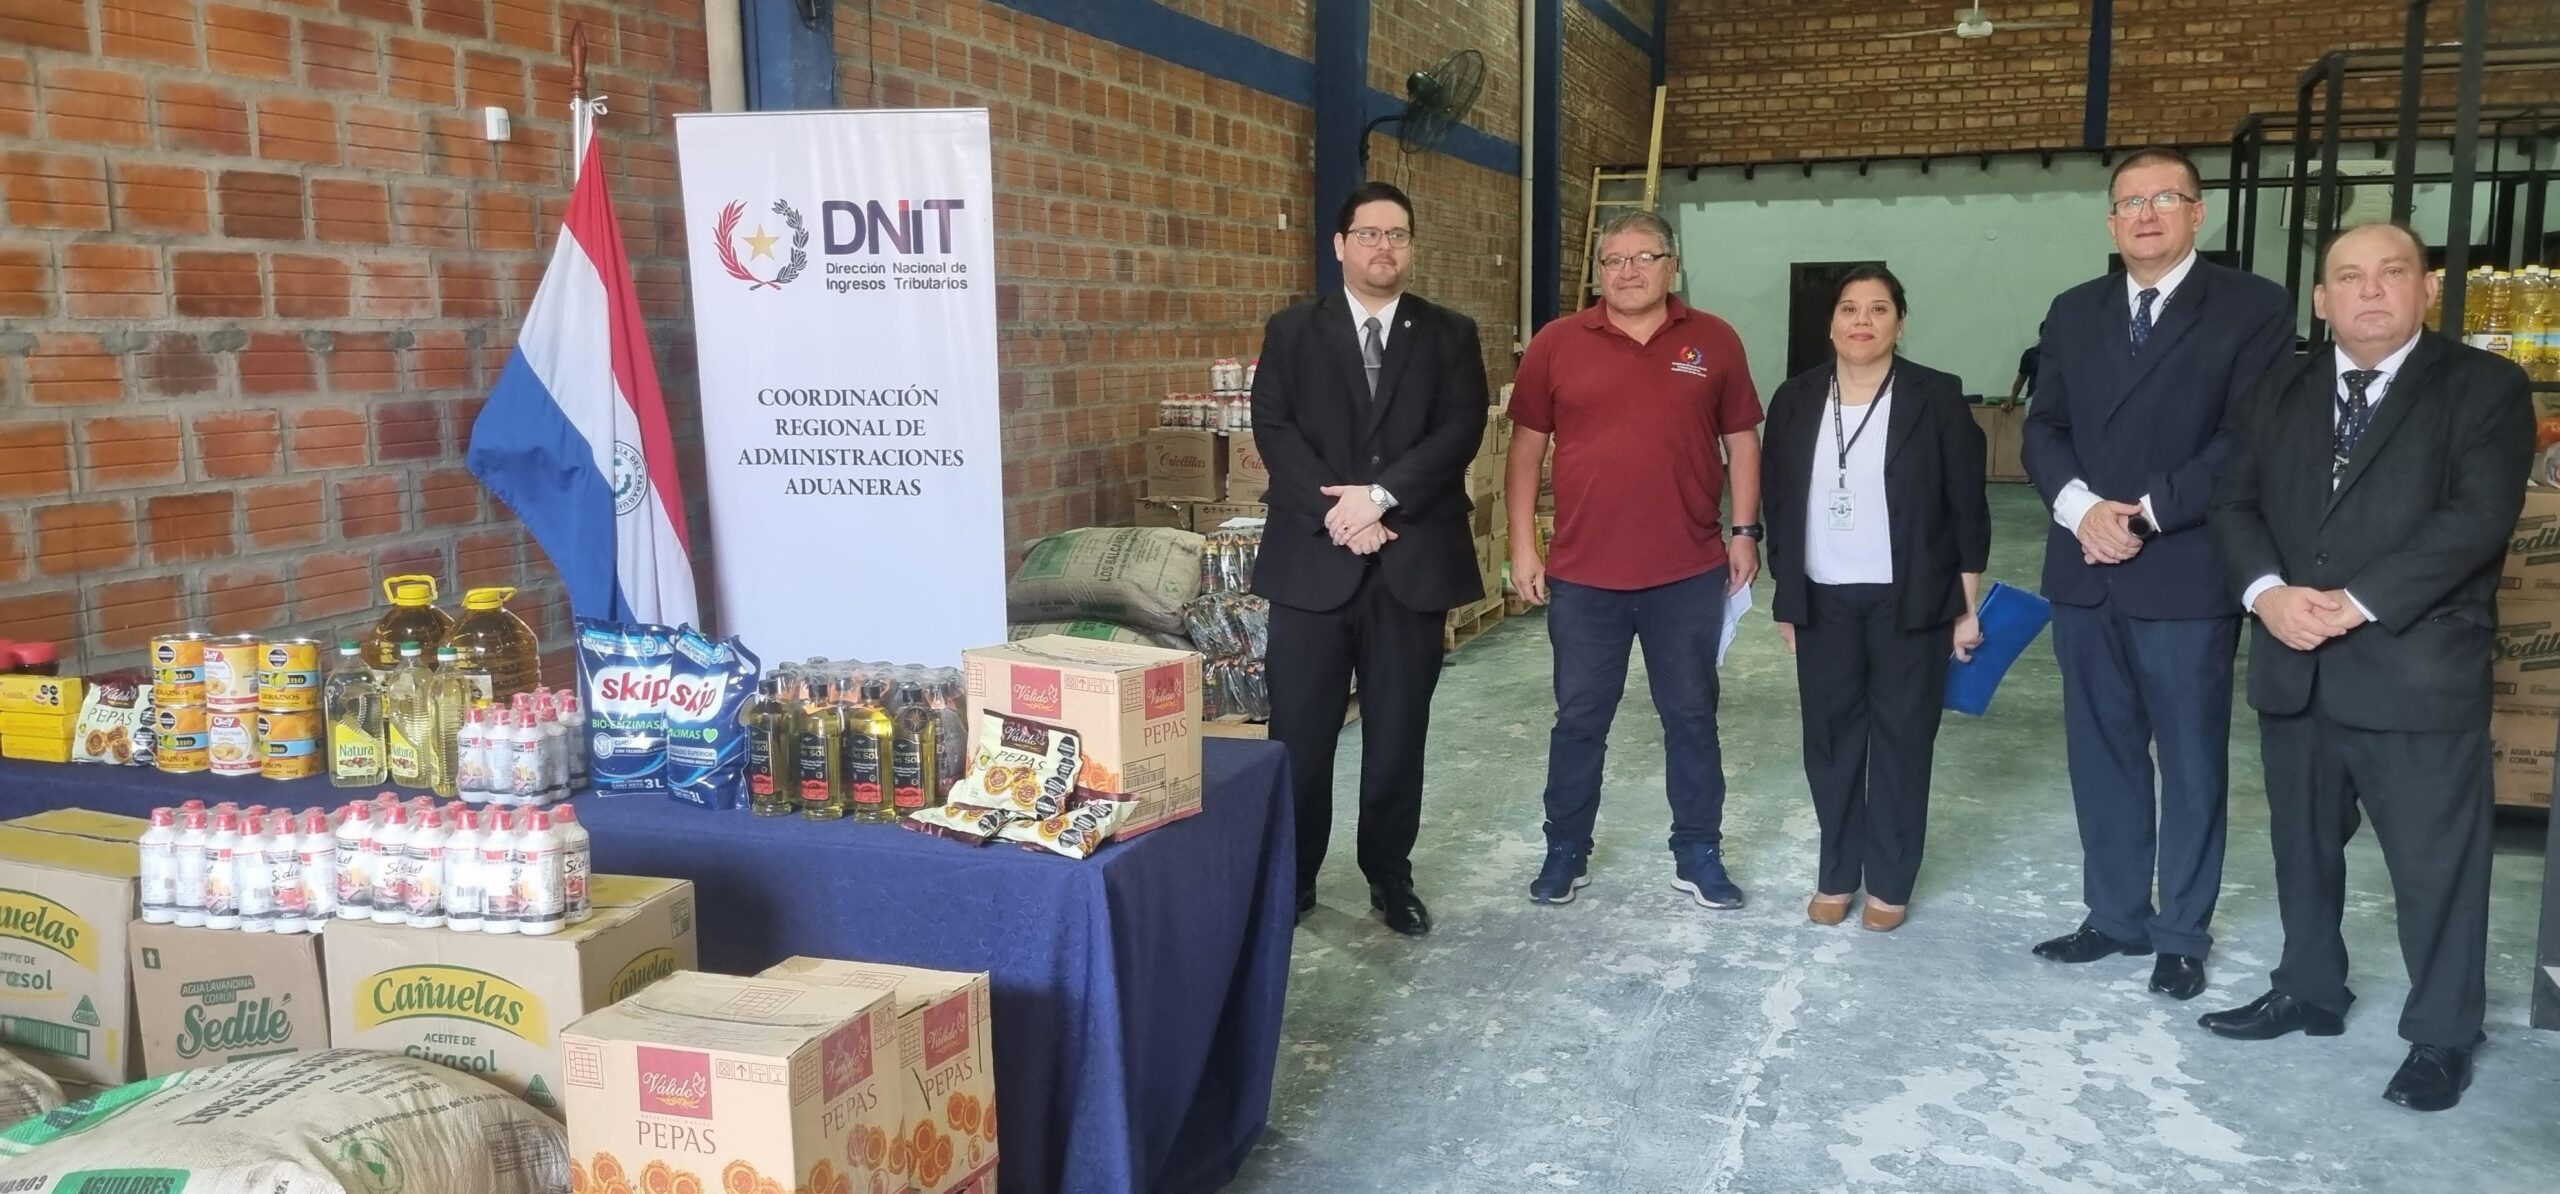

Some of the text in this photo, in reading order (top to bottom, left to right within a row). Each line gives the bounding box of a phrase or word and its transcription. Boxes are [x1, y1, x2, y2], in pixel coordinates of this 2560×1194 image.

[826, 262, 967, 274] Dirección Nacional de
[826, 277, 968, 294] Ingresos Tributarios
[758, 384, 939, 407] COORDINACIÓN
[775, 419, 926, 437] REGIONAL DE
[738, 448, 965, 467] ADMINISTRACIONES
[784, 478, 922, 496] ADUANERAS
[1099, 563, 1114, 582] LOS
[601, 671, 670, 708] skip
[669, 681, 717, 718] skip
[1013, 683, 1050, 704] Válido
[87, 707, 133, 726] PEPAS
[1003, 726, 1037, 747] Válido
[1144, 717, 1188, 747] PEPAS
[339, 744, 374, 757] Natura
[994, 750, 1047, 771] PEPAS
[0, 904, 80, 949] uelas
[24, 955, 36, 965] DE
[182, 977, 254, 995] AGUA LAVANDINA
[374, 975, 524, 1027] Cañuelas
[176, 993, 293, 1059] Sedilé
[926, 1021, 959, 1051] Válido
[423, 1033, 476, 1047] ACEITE DE
[642, 1072, 693, 1098] Válido
[923, 1055, 974, 1100] PEPAS
[233, 1074, 327, 1118] INGENIO
[821, 1083, 878, 1140] PEPAS
[636, 1119, 717, 1156] PEPAS
